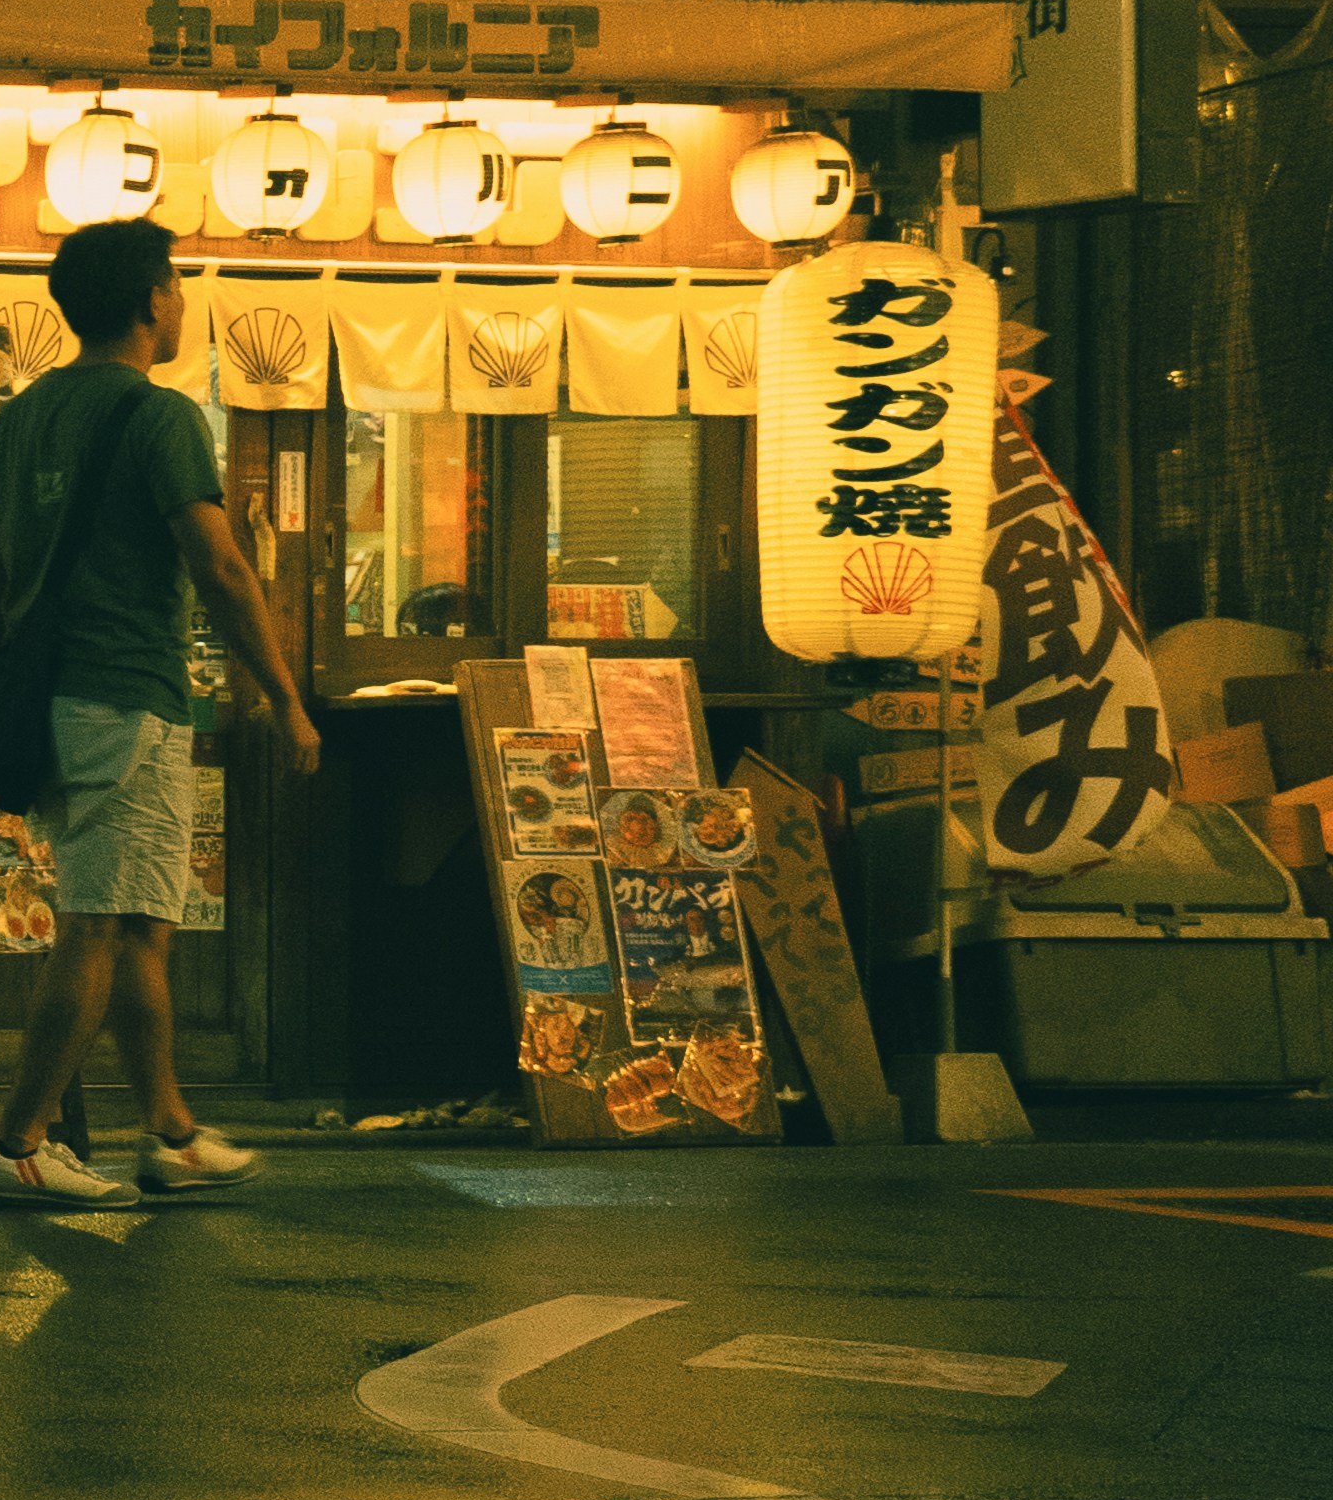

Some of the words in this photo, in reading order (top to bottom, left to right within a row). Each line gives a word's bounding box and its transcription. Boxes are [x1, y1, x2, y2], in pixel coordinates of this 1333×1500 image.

[815, 277, 957, 539] ガンガン焼
